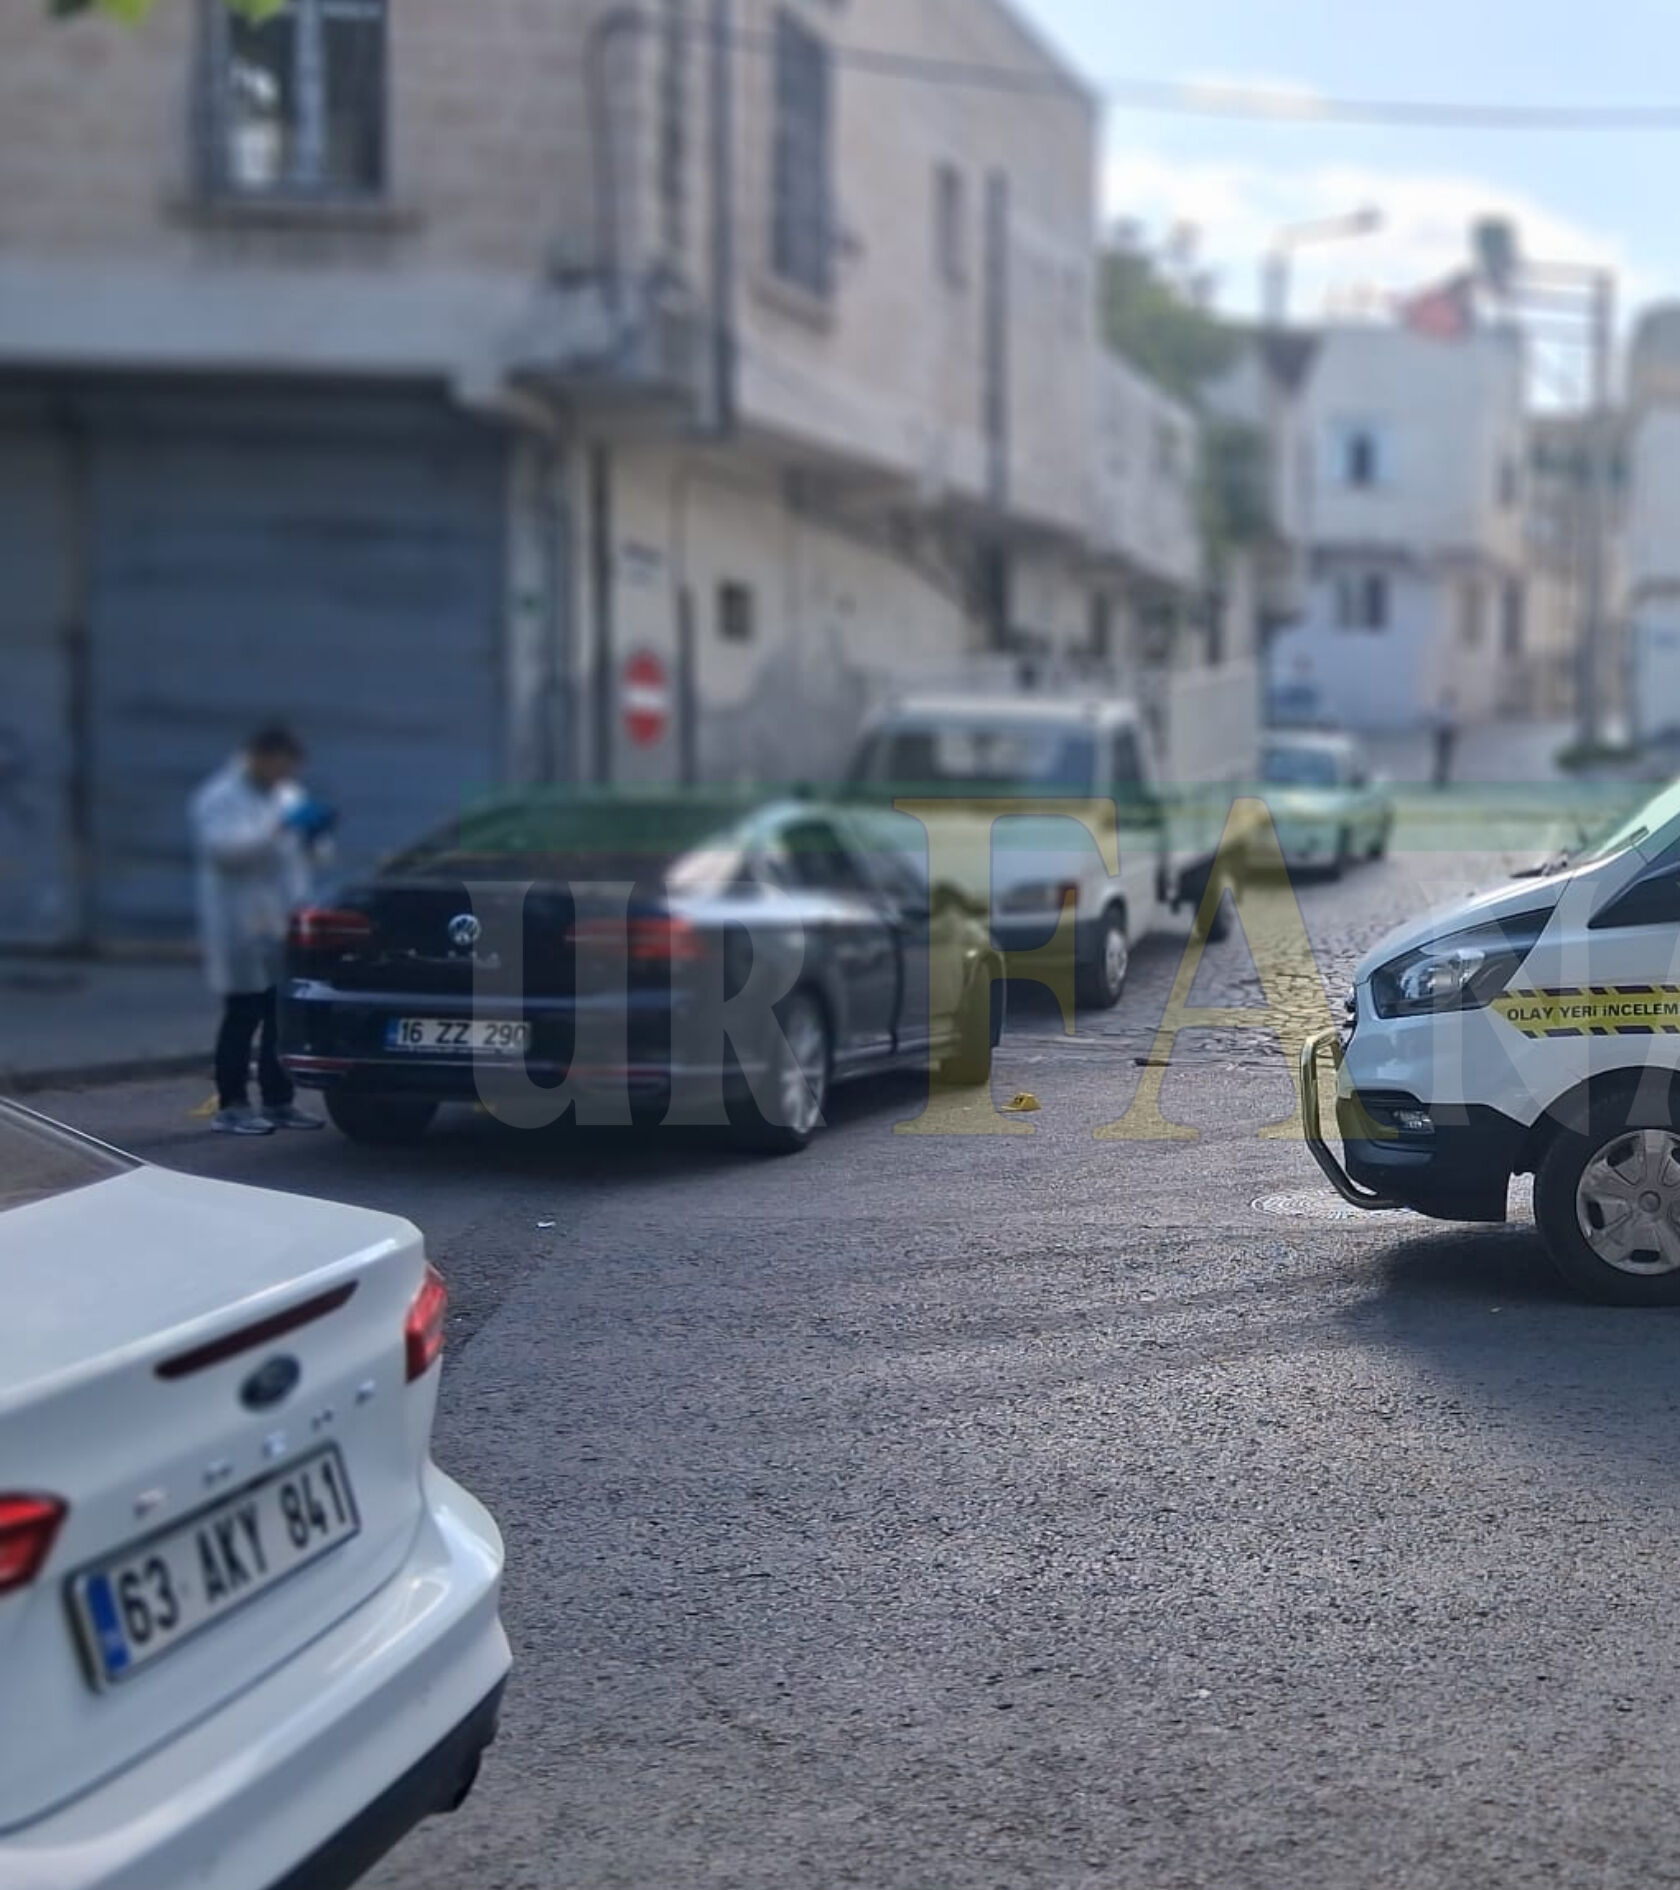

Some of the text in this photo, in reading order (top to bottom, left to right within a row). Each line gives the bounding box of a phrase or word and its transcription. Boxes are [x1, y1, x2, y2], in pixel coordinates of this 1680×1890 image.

[1507, 1007, 1554, 1021] OLAY
[401, 1020, 527, 1046] 16 ZZ 290
[119, 1459, 347, 1645] 63 AKY 841
